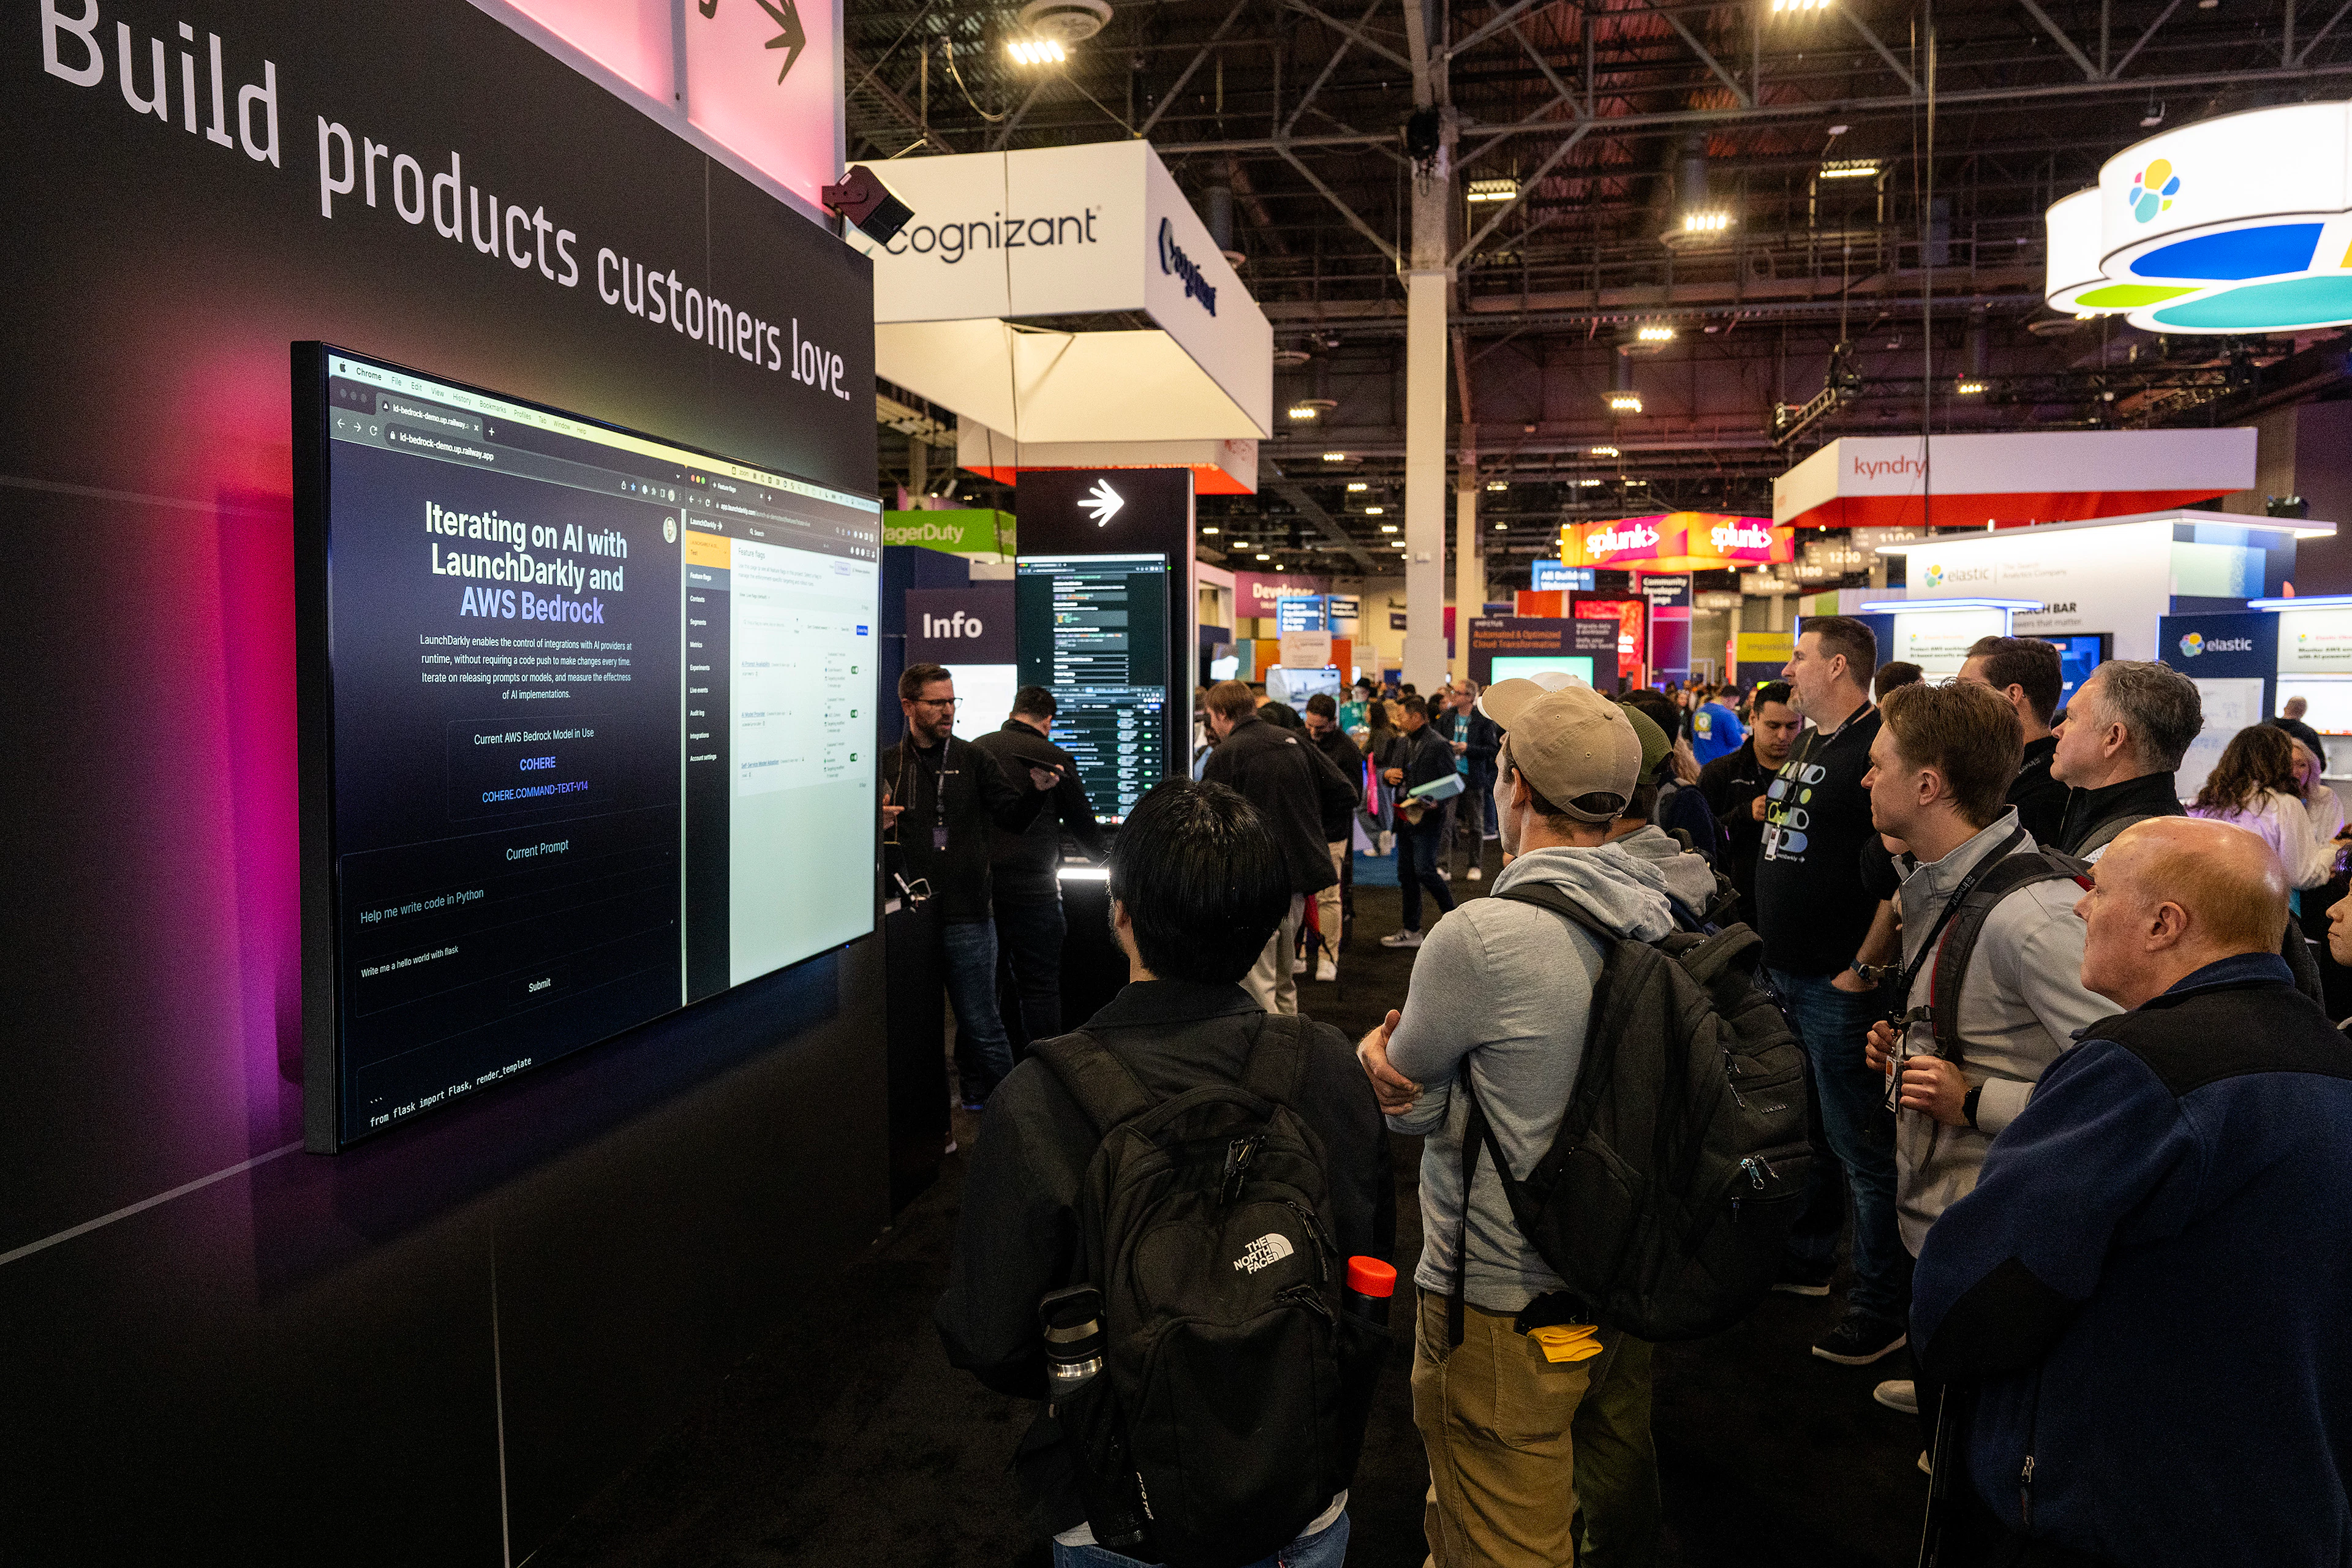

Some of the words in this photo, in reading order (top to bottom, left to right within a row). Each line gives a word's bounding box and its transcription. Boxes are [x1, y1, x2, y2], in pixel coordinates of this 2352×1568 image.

[40, 0, 280, 168] Build
[318, 115, 578, 287] products
[597, 246, 781, 371] customers
[791, 317, 850, 401] love.
[356, 368, 382, 381] Chrome
[391, 377, 402, 387] File
[411, 382, 422, 392] Edit
[431, 388, 445, 398] View
[453, 393, 472, 405] History
[480, 400, 507, 414] Bookmarks
[514, 409, 531, 420] Profiles
[554, 420, 570, 431] Window
[399, 432, 494, 461] ld-bedrock-demo.up.railway.app
[1855, 454, 1926, 480] kyndry
[426, 500, 526, 552] Iterating
[532, 524, 557, 549] on
[562, 522, 583, 552] AI
[587, 528, 628, 559] with
[883, 523, 964, 545] agerDuty
[738, 547, 755, 557] Feature
[755, 549, 766, 560] flags
[432, 543, 585, 594] LaunchDarkly
[590, 566, 624, 592] and
[690, 572, 703, 581] Feature
[1541, 571, 1554, 581] All
[1948, 566, 1990, 582] elastic
[1541, 581, 1579, 591] Welcome
[1643, 576, 1688, 587] Community
[460, 586, 516, 619] AWS
[522, 591, 605, 624] Bedrock
[2053, 601, 2077, 614] BAR
[923, 611, 983, 639] Info
[420, 634, 470, 649] LaunchDarkly
[472, 637, 499, 648] enables
[500, 637, 511, 647] the
[513, 638, 535, 649] control
[537, 638, 543, 648] of
[545, 639, 579, 650] integrations
[581, 640, 593, 649] with
[594, 640, 600, 649] AI
[601, 641, 625, 652] providers
[1472, 631, 1515, 639] Automated
[1522, 631, 1562, 639] Optimized
[1472, 639, 1498, 648] Cloud
[1499, 640, 1562, 649] Transformation
[2206, 637, 2252, 652] elastic
[421, 654, 452, 666] runtime,
[454, 654, 481, 665] without
[483, 655, 512, 668] requiring
[519, 655, 535, 665] code
[537, 655, 551, 668] push
[552, 657, 560, 665] to
[560, 656, 576, 666] make
[578, 657, 601, 668] changes
[602, 658, 617, 668] every
[618, 657, 631, 666] time.
[421, 673, 447, 683] Iterate
[448, 674, 458, 683] on
[459, 673, 491, 685] releasing
[492, 673, 520, 684] prompts
[529, 673, 554, 684] models,
[555, 673, 566, 682] and
[567, 673, 592, 682] measure
[593, 673, 602, 682] the
[603, 673, 631, 682] effectness
[502, 690, 510, 699] of
[511, 690, 518, 699] AI
[519, 689, 571, 701] implementations.
[474, 734, 503, 745] Current
[504, 733, 522, 744] AWS
[523, 731, 551, 742] Bedrock
[552, 729, 573, 741] Model
[575, 729, 581, 739] in
[581, 728, 594, 739] Use
[690, 731, 709, 740] Integrations
[519, 756, 556, 771] COHERE
[704, 753, 717, 761] settings
[482, 780, 589, 803] COHERE.COMMAND-TEXT-V14
[506, 845, 538, 861] Current
[540, 839, 569, 854] Prompt
[360, 909, 382, 924] Help
[384, 908, 398, 919] me
[401, 902, 423, 915] write
[424, 897, 445, 910] code
[447, 894, 454, 905] in
[456, 888, 484, 905] Python
[361, 966, 379, 978] Write
[380, 964, 390, 973] me
[397, 957, 412, 969] hello
[413, 952, 430, 965] world
[431, 949, 443, 960] with
[445, 944, 459, 956] flask
[528, 978, 551, 993] Submit
[370, 1112, 390, 1128] from
[393, 1101, 416, 1118] flask
[419, 1090, 445, 1109] import
[448, 1080, 473, 1097] Flask,
[476, 1057, 532, 1086] render_template
[1245, 1236, 1269, 1253] THE
[1233, 1245, 1272, 1271] NORTH
[1247, 1254, 1275, 1274] FACE
